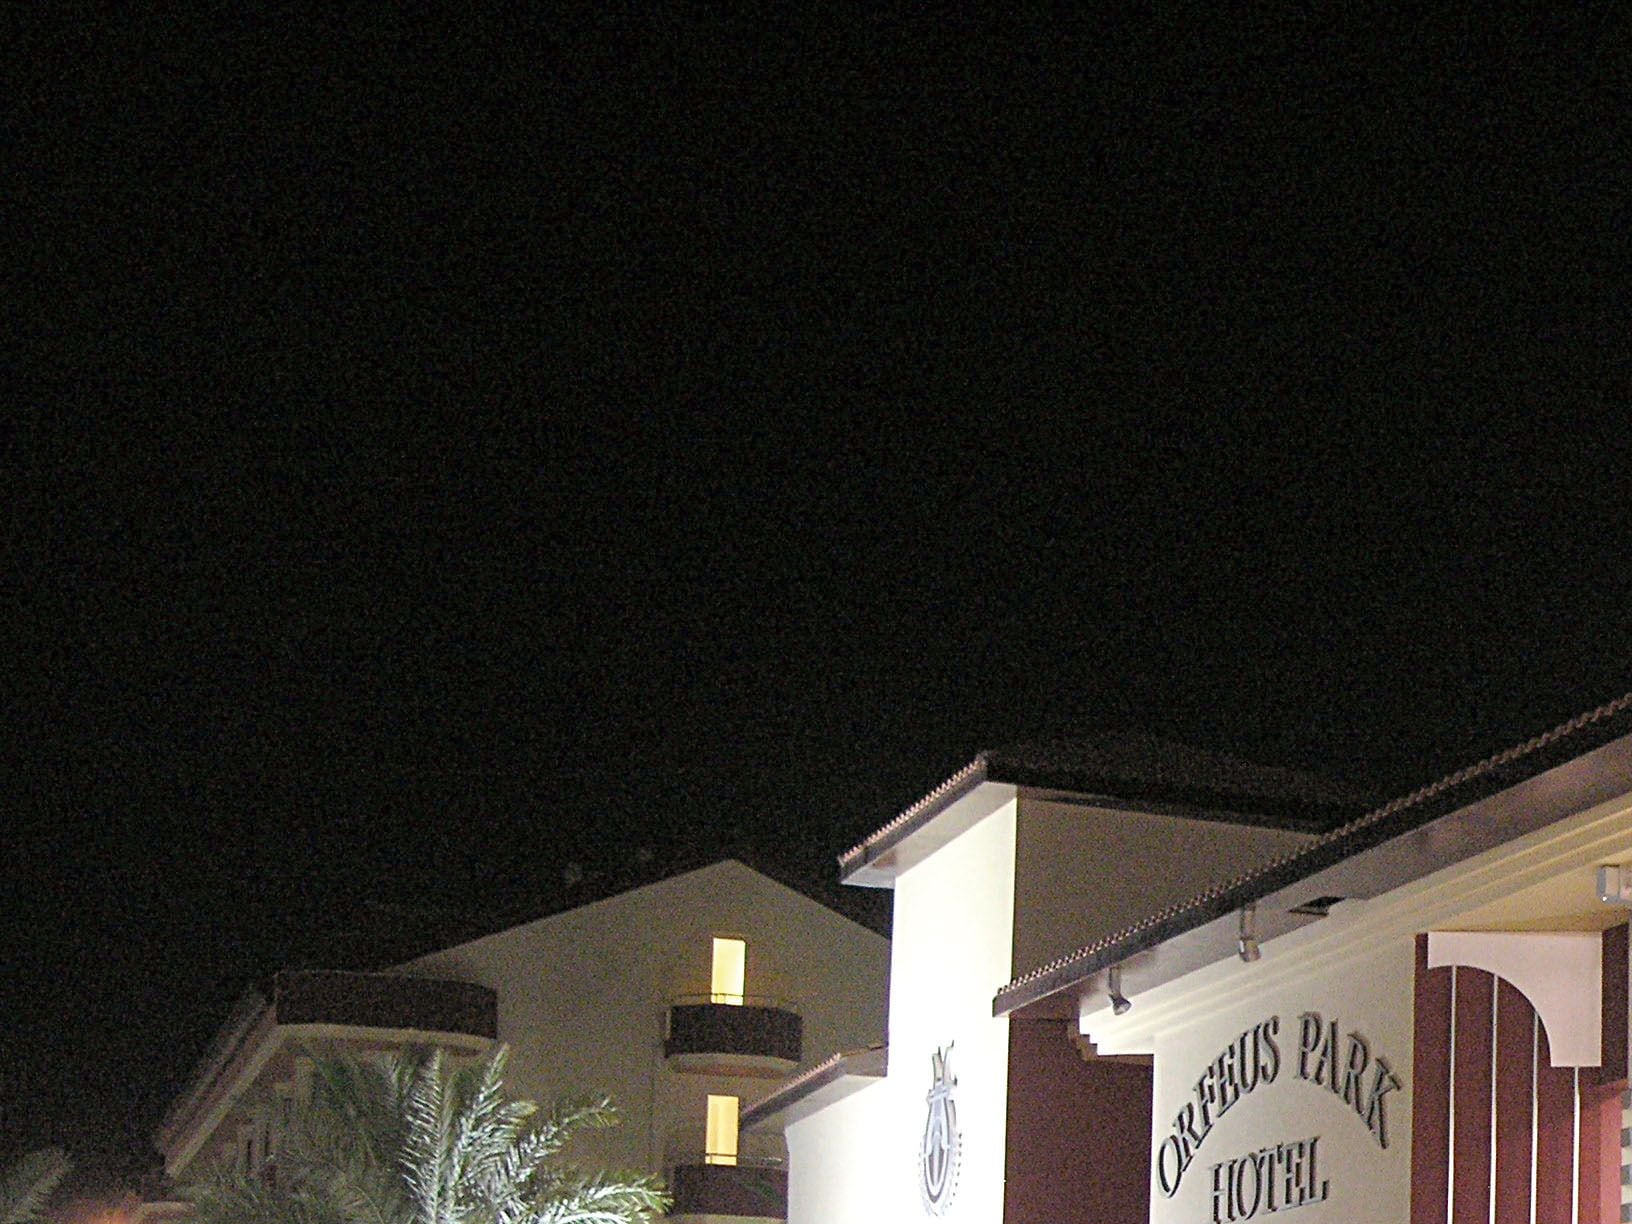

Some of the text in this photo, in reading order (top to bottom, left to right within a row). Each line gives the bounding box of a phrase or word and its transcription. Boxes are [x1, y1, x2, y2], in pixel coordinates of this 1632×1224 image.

[1157, 1011, 1402, 1198] ORFEUS PARK
[1209, 1136, 1330, 1224] HOTEL
